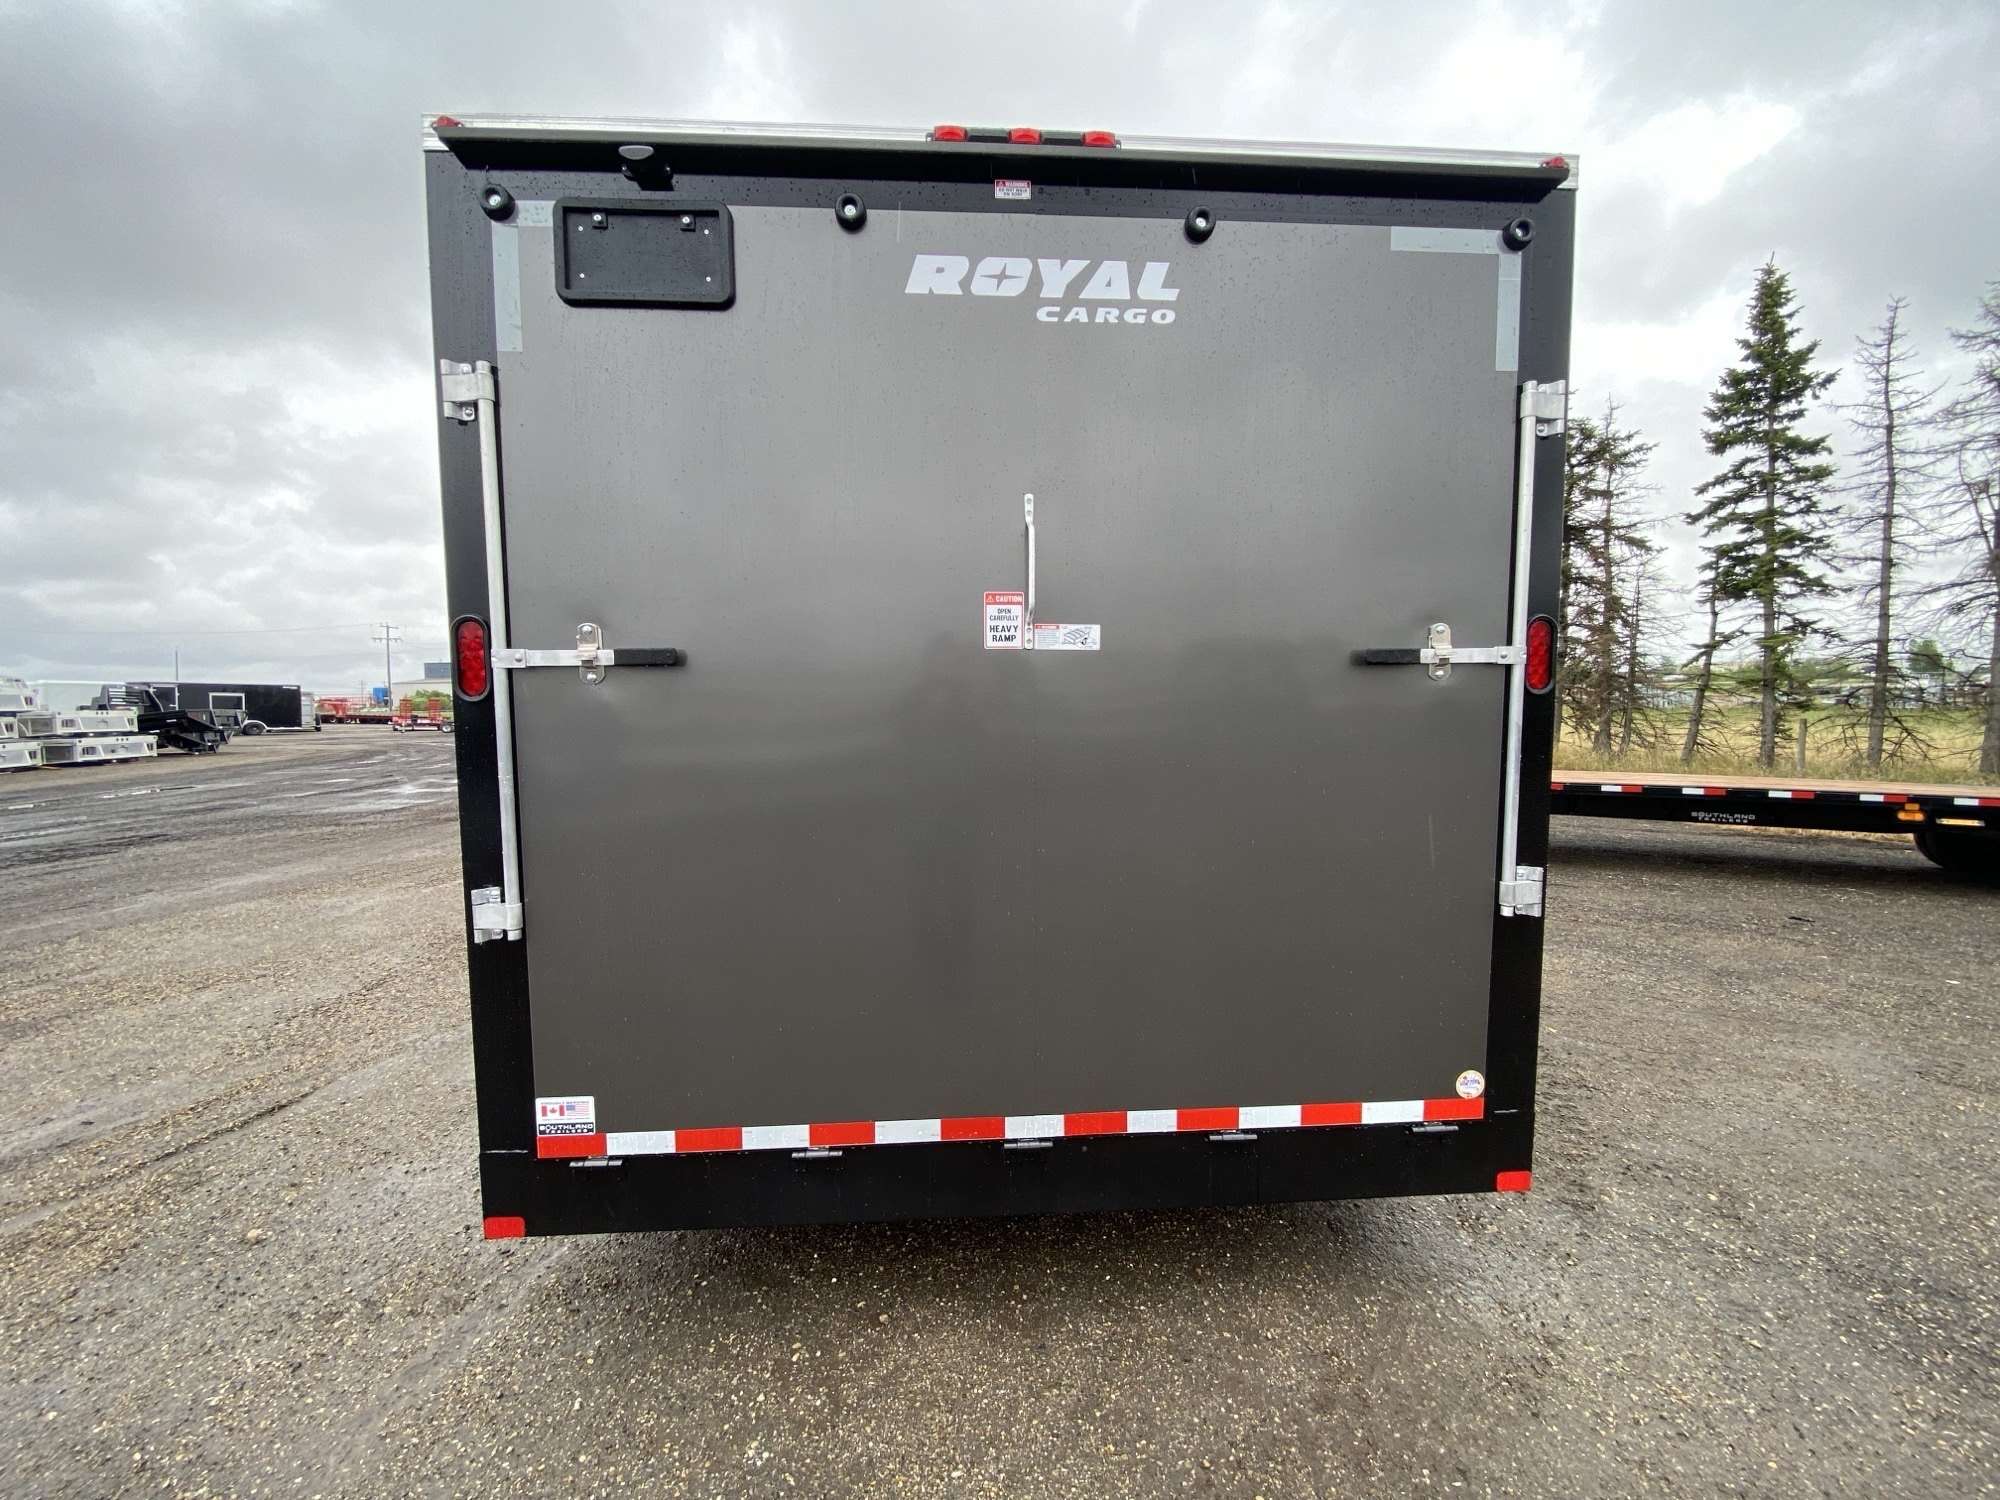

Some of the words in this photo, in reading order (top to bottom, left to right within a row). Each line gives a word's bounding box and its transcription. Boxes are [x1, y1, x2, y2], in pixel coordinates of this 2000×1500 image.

[904, 254, 1181, 301] ROYAL
[1036, 306, 1177, 324] CARGO
[995, 595, 1023, 603] CAUTION
[989, 624, 1019, 633] HEAVY
[992, 634, 1017, 643] RAMP
[1691, 812, 1755, 820] SOUTHLAND
